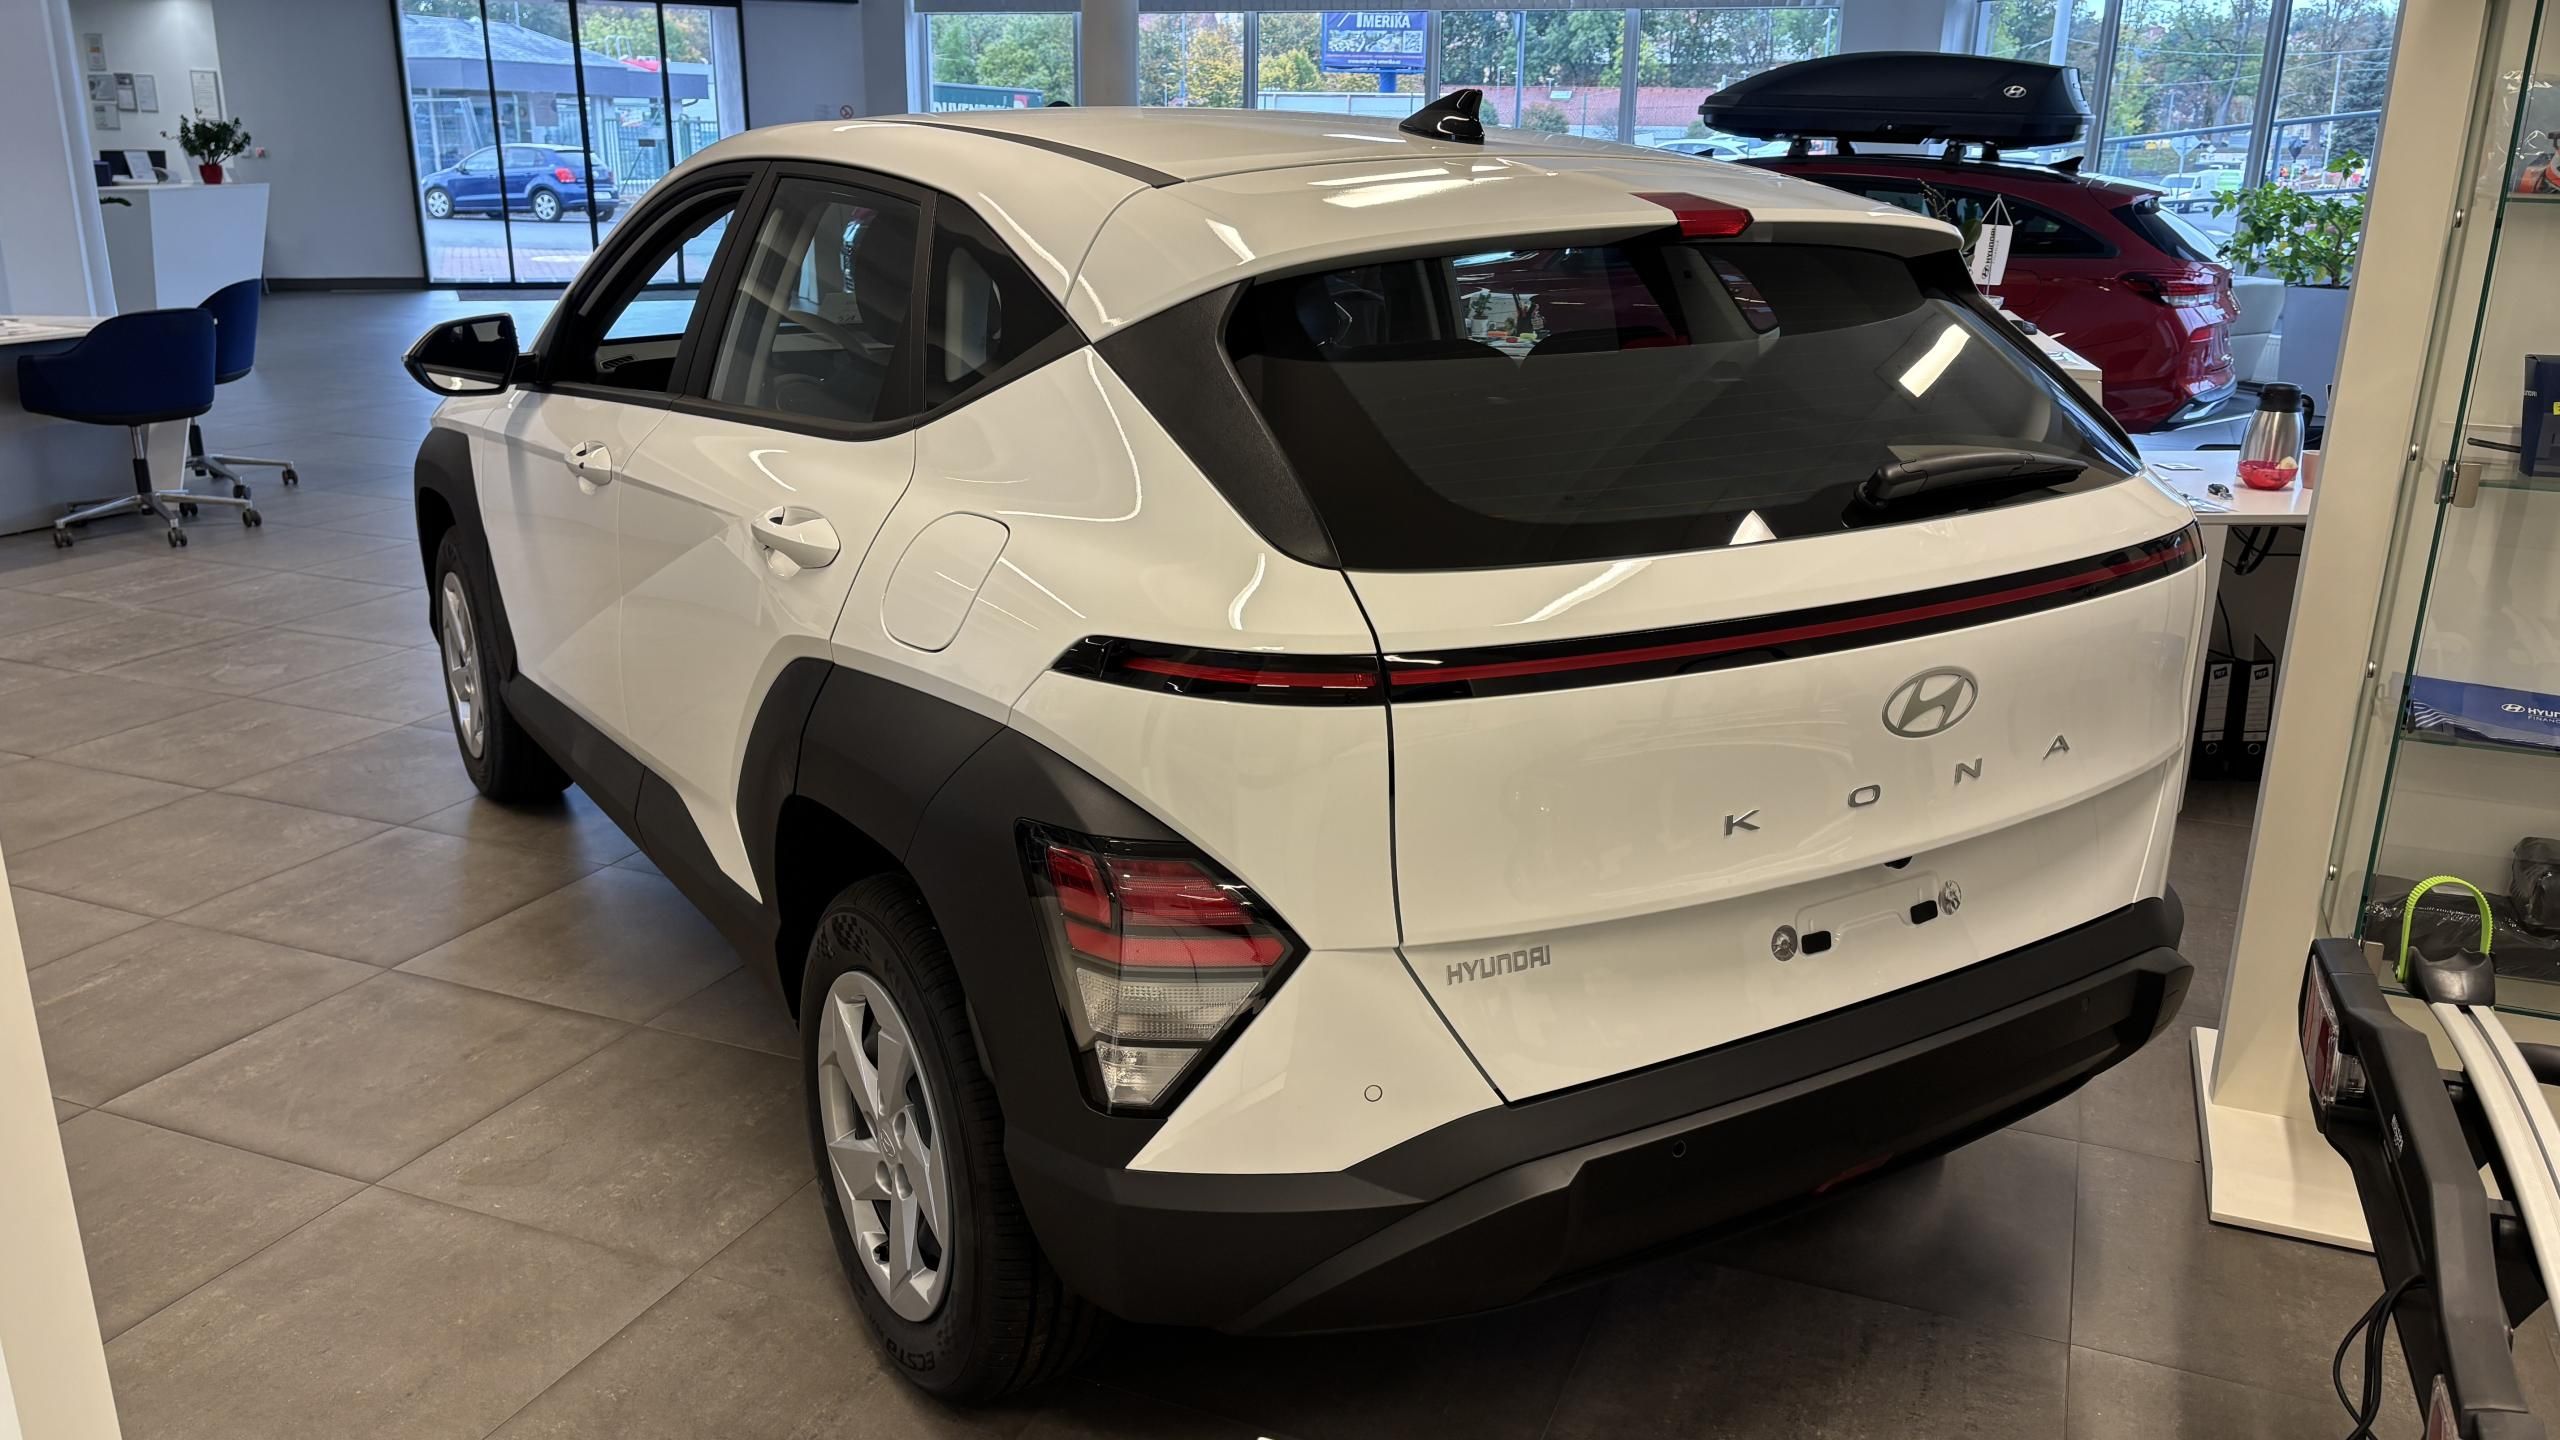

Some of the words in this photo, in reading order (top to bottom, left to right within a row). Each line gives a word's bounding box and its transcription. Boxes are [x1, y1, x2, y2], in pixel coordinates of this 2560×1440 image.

[1985, 228, 1996, 264] HYUNDAI
[1724, 735, 2070, 838] KONA
[1446, 944, 1551, 986] HYUNDAI
